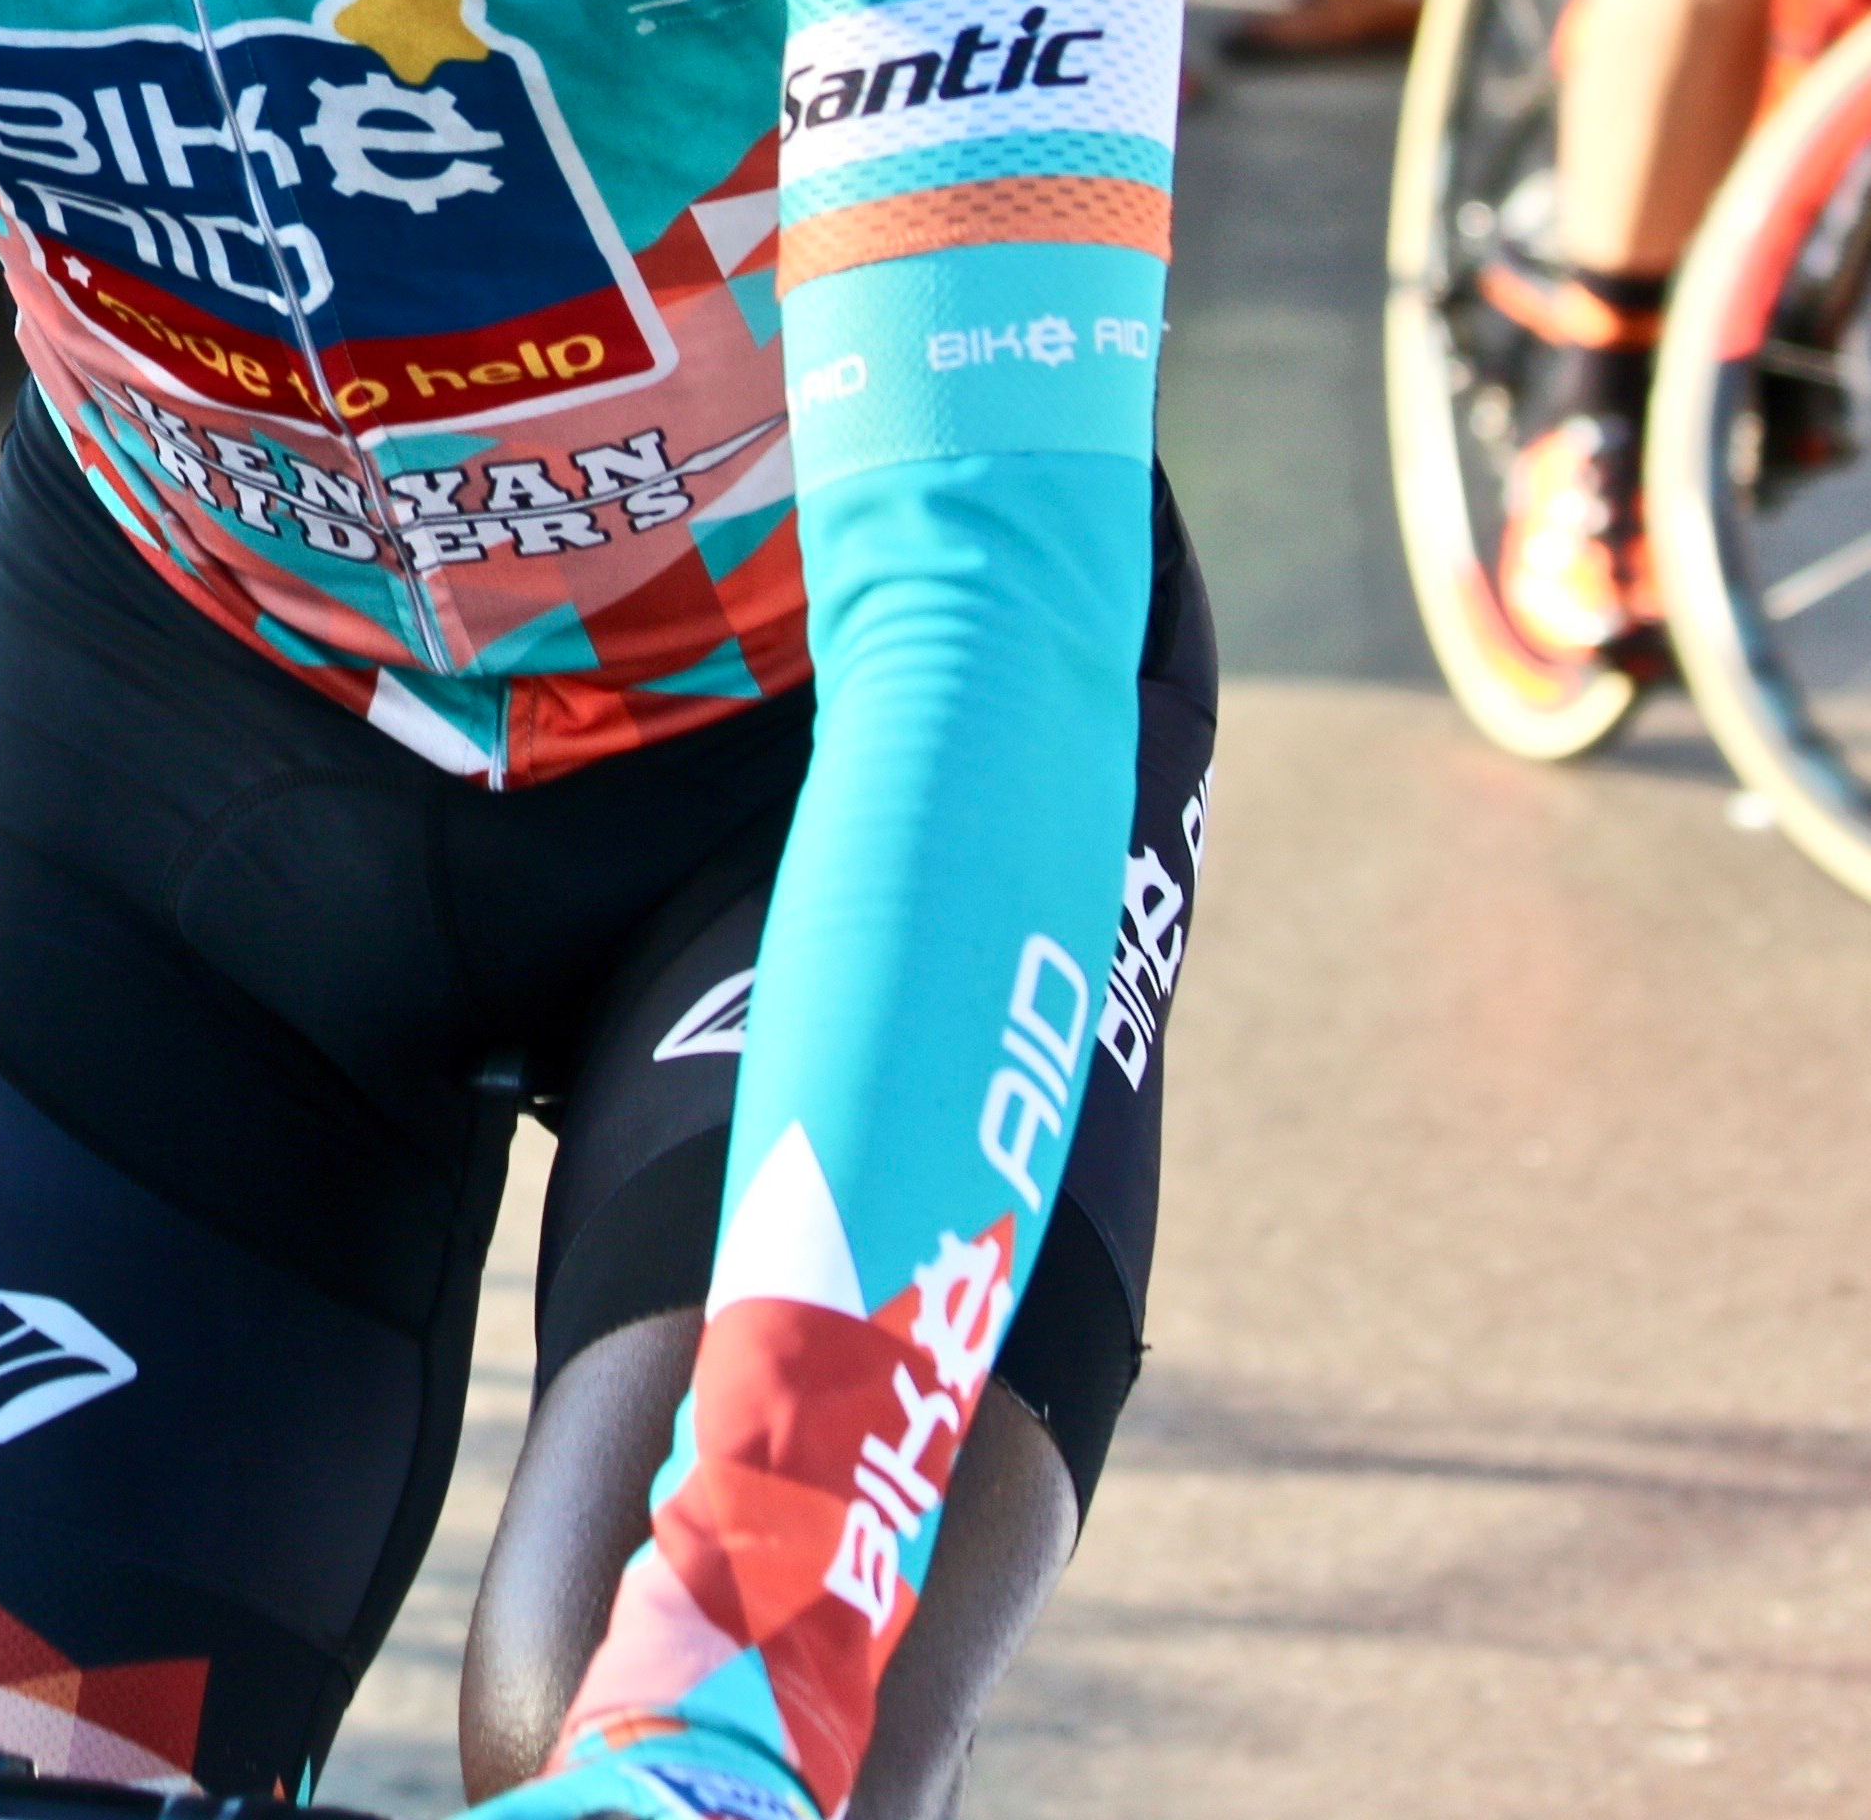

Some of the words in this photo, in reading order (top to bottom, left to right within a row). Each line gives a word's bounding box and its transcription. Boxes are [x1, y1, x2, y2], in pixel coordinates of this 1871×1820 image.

[780, 6, 1104, 145] Santic
[405, 333, 605, 399] help
[128, 386, 681, 526] KENYAN
[150, 422, 694, 575] RIDERS
